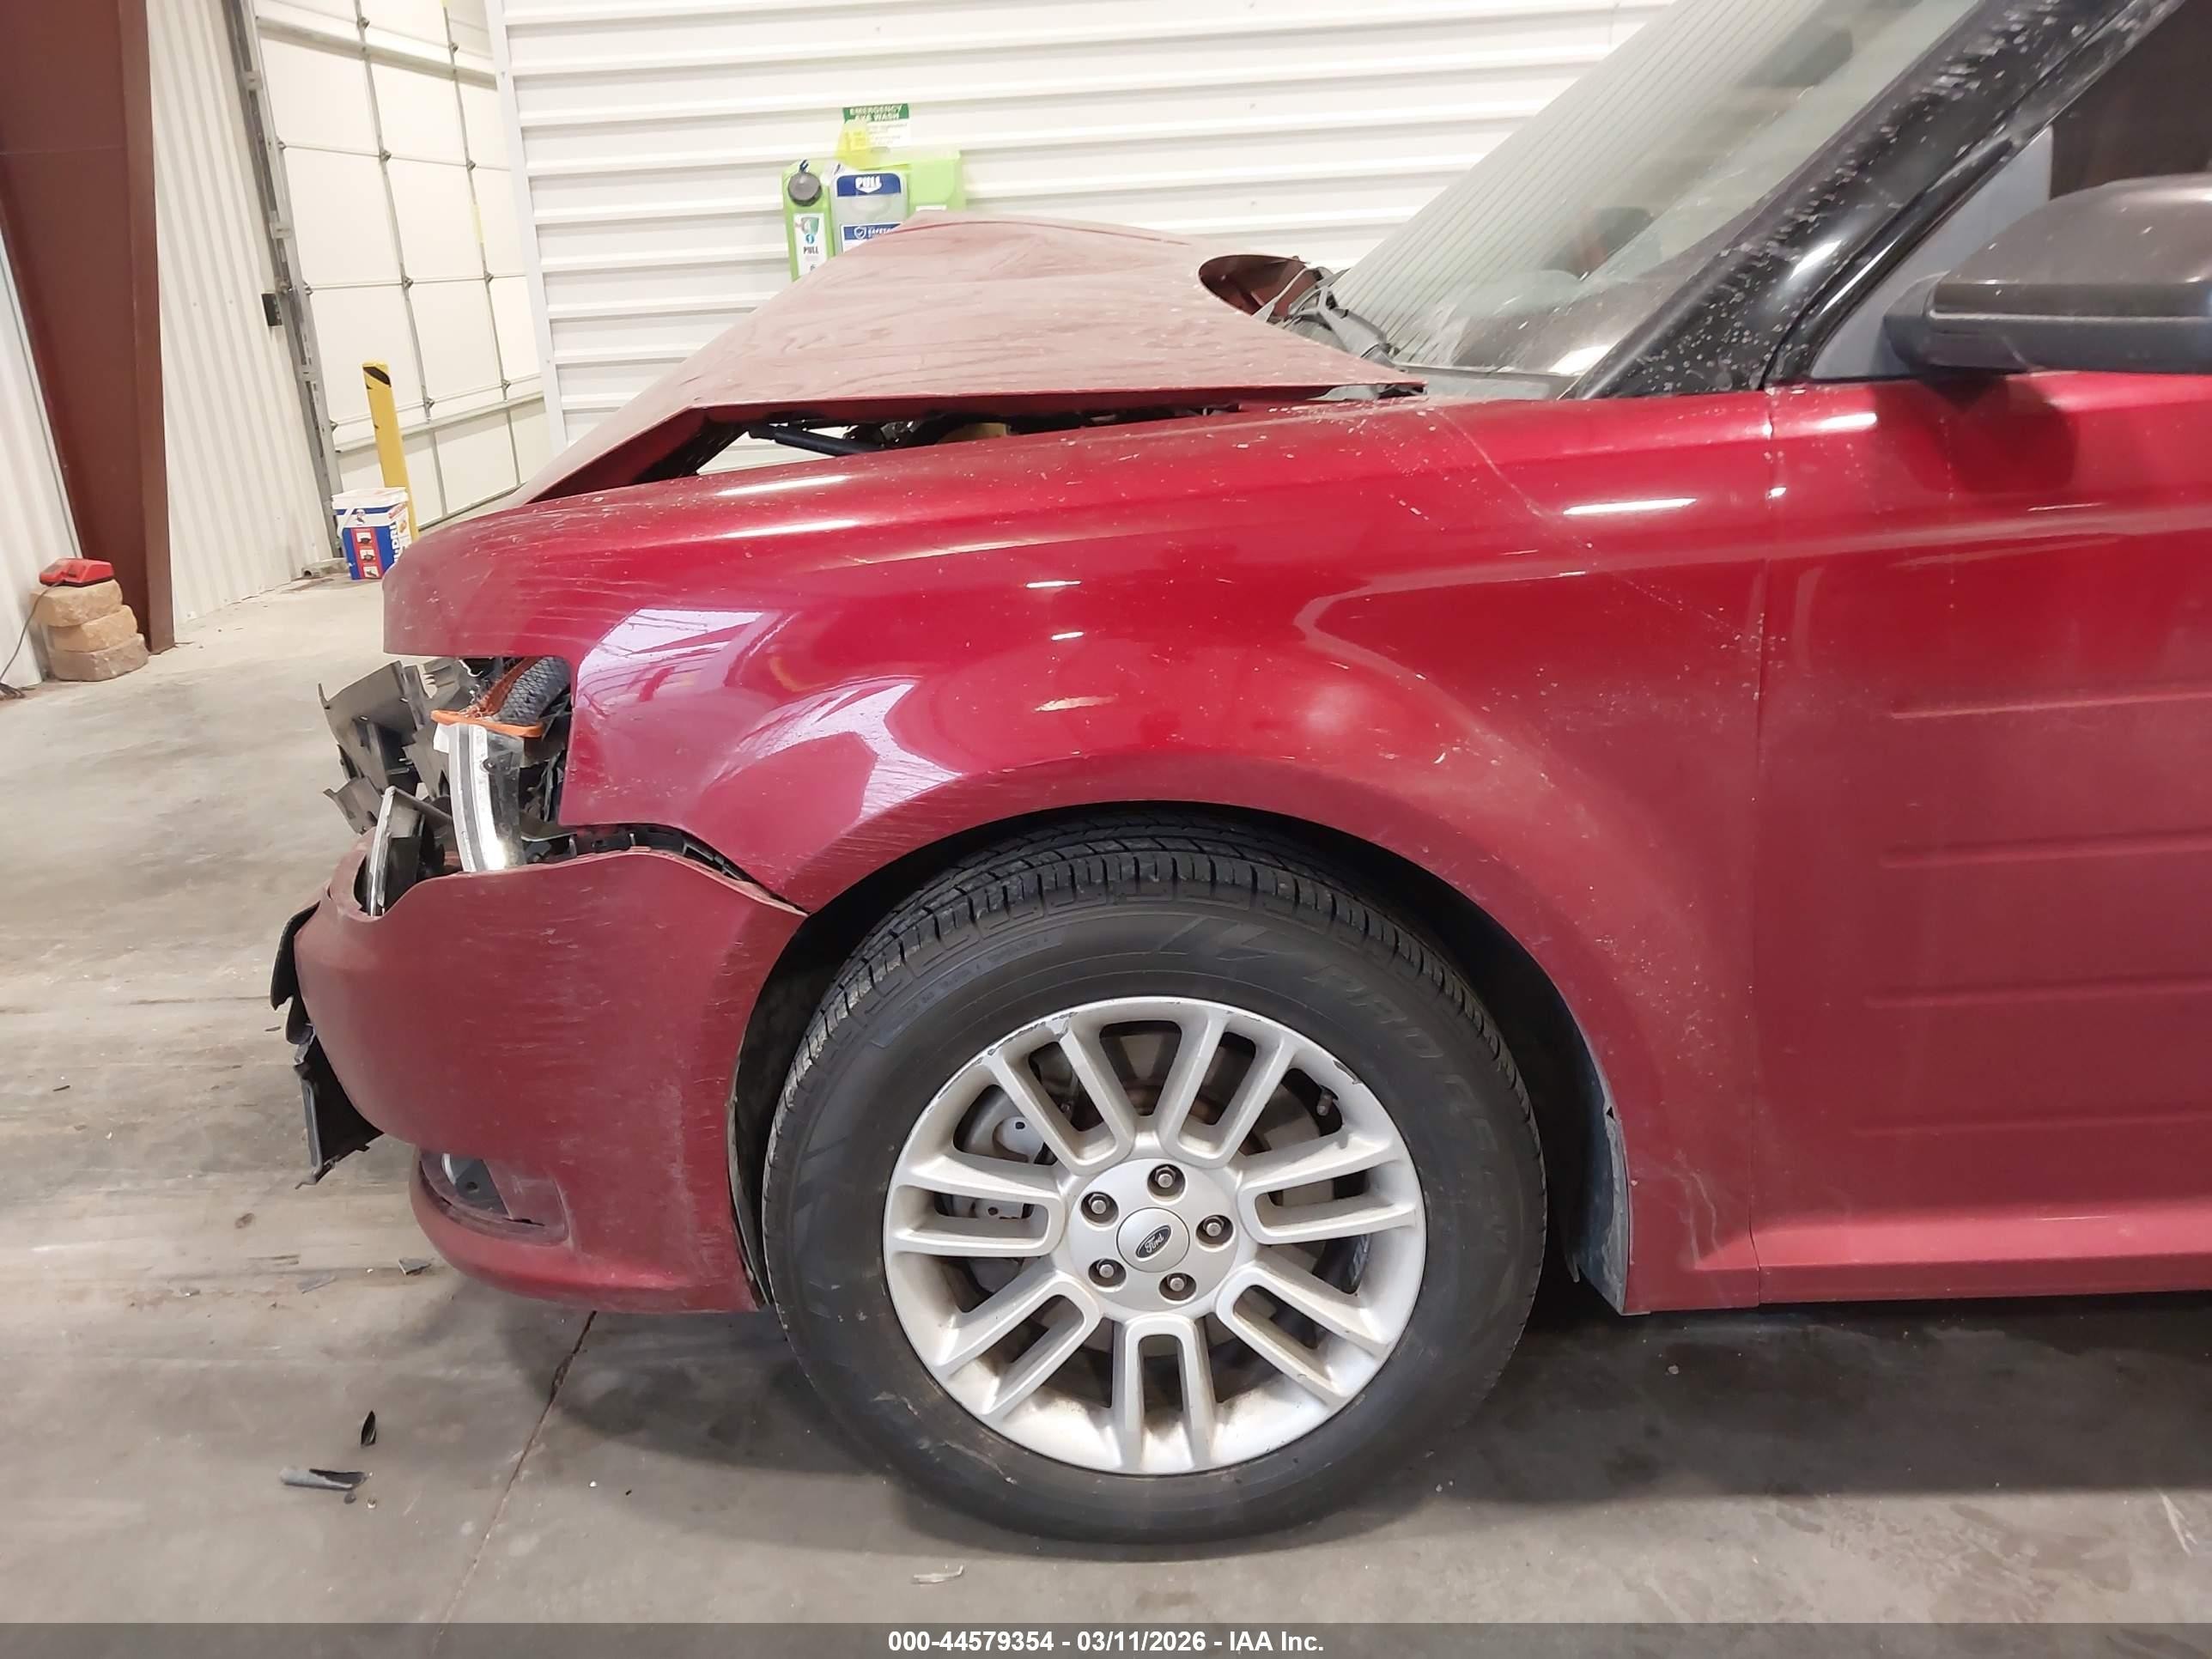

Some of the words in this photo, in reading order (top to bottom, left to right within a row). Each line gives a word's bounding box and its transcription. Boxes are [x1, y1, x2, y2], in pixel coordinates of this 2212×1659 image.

[849, 105, 902, 115] EMERGENCY
[855, 176, 882, 187] PULL
[803, 246, 818, 255] PULL
[1145, 1233, 1164, 1254] Ford
